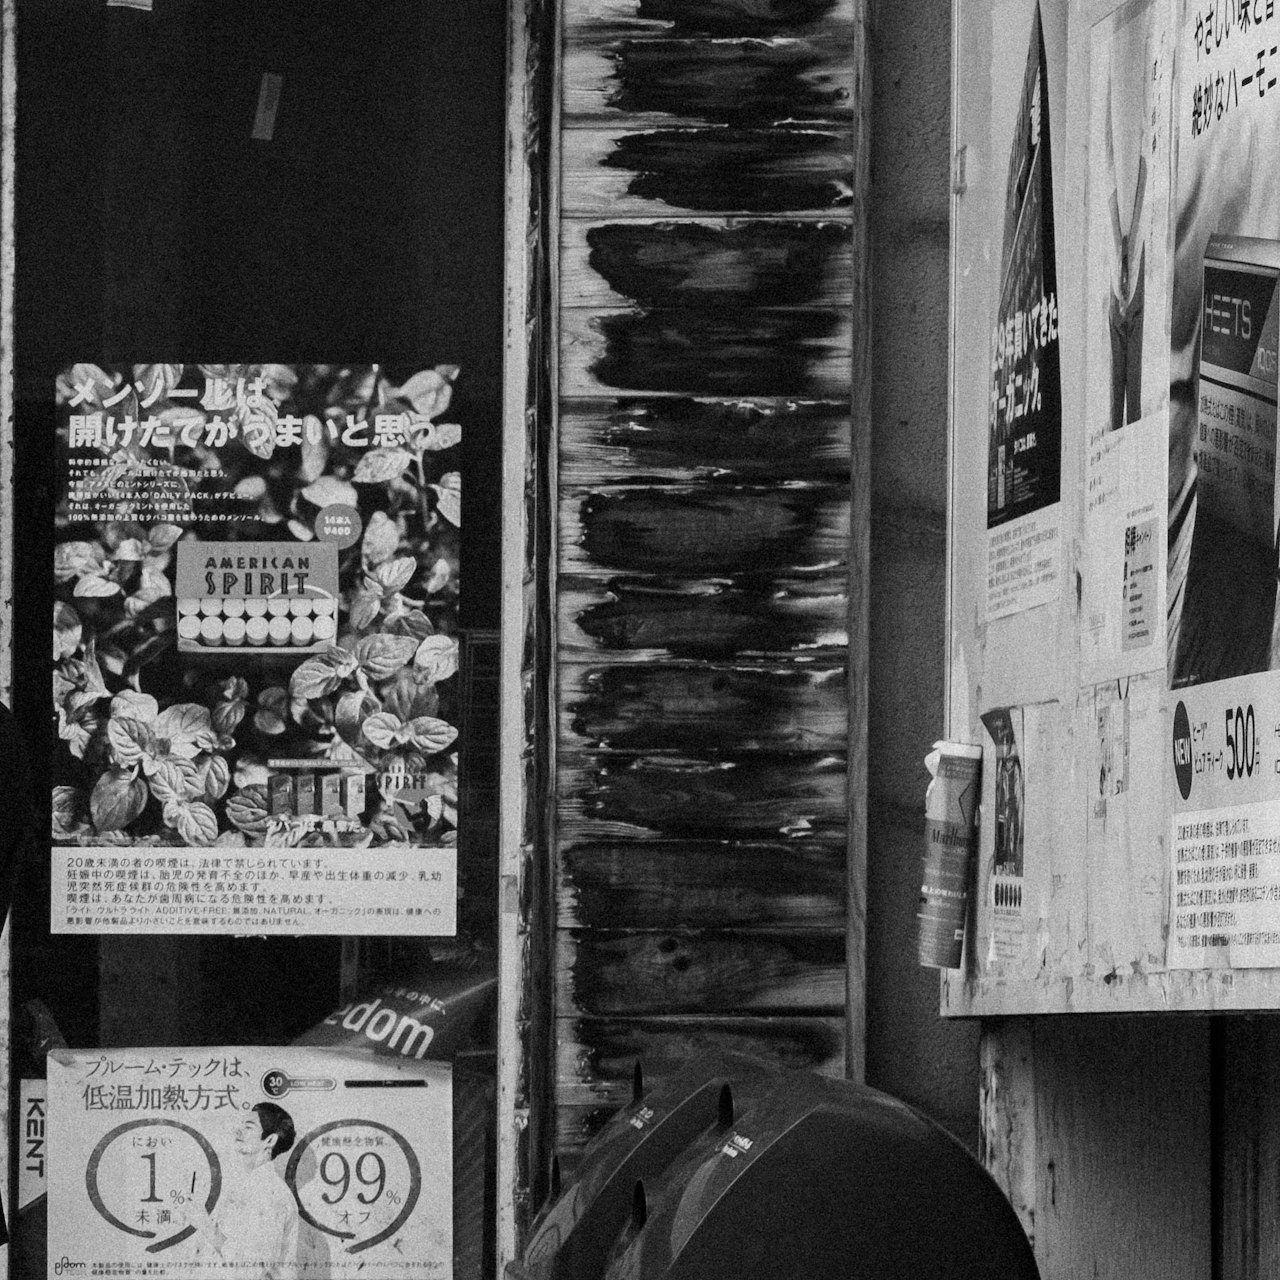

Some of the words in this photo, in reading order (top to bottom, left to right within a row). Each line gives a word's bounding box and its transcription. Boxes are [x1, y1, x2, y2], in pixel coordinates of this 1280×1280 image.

[1204, 293, 1252, 340] HEETS
[67, 377, 269, 411] メンソールは
[67, 414, 438, 449] 開けたてがうまいと思う
[323, 526, 352, 536] ¥400
[324, 515, 352, 526] 14本入
[204, 556, 310, 570] AMERICAN
[204, 570, 310, 596] SPIRIT
[1174, 737, 1191, 766] NEW
[84, 1055, 253, 1079] プルーム・テックは、
[268, 1076, 283, 1088] 30
[81, 1083, 257, 1112] 低温加熱方式。
[25, 1097, 46, 1178] KENT
[131, 1135, 174, 1149] におい
[318, 1150, 403, 1207] 99%
[340, 1210, 373, 1225] オフ
